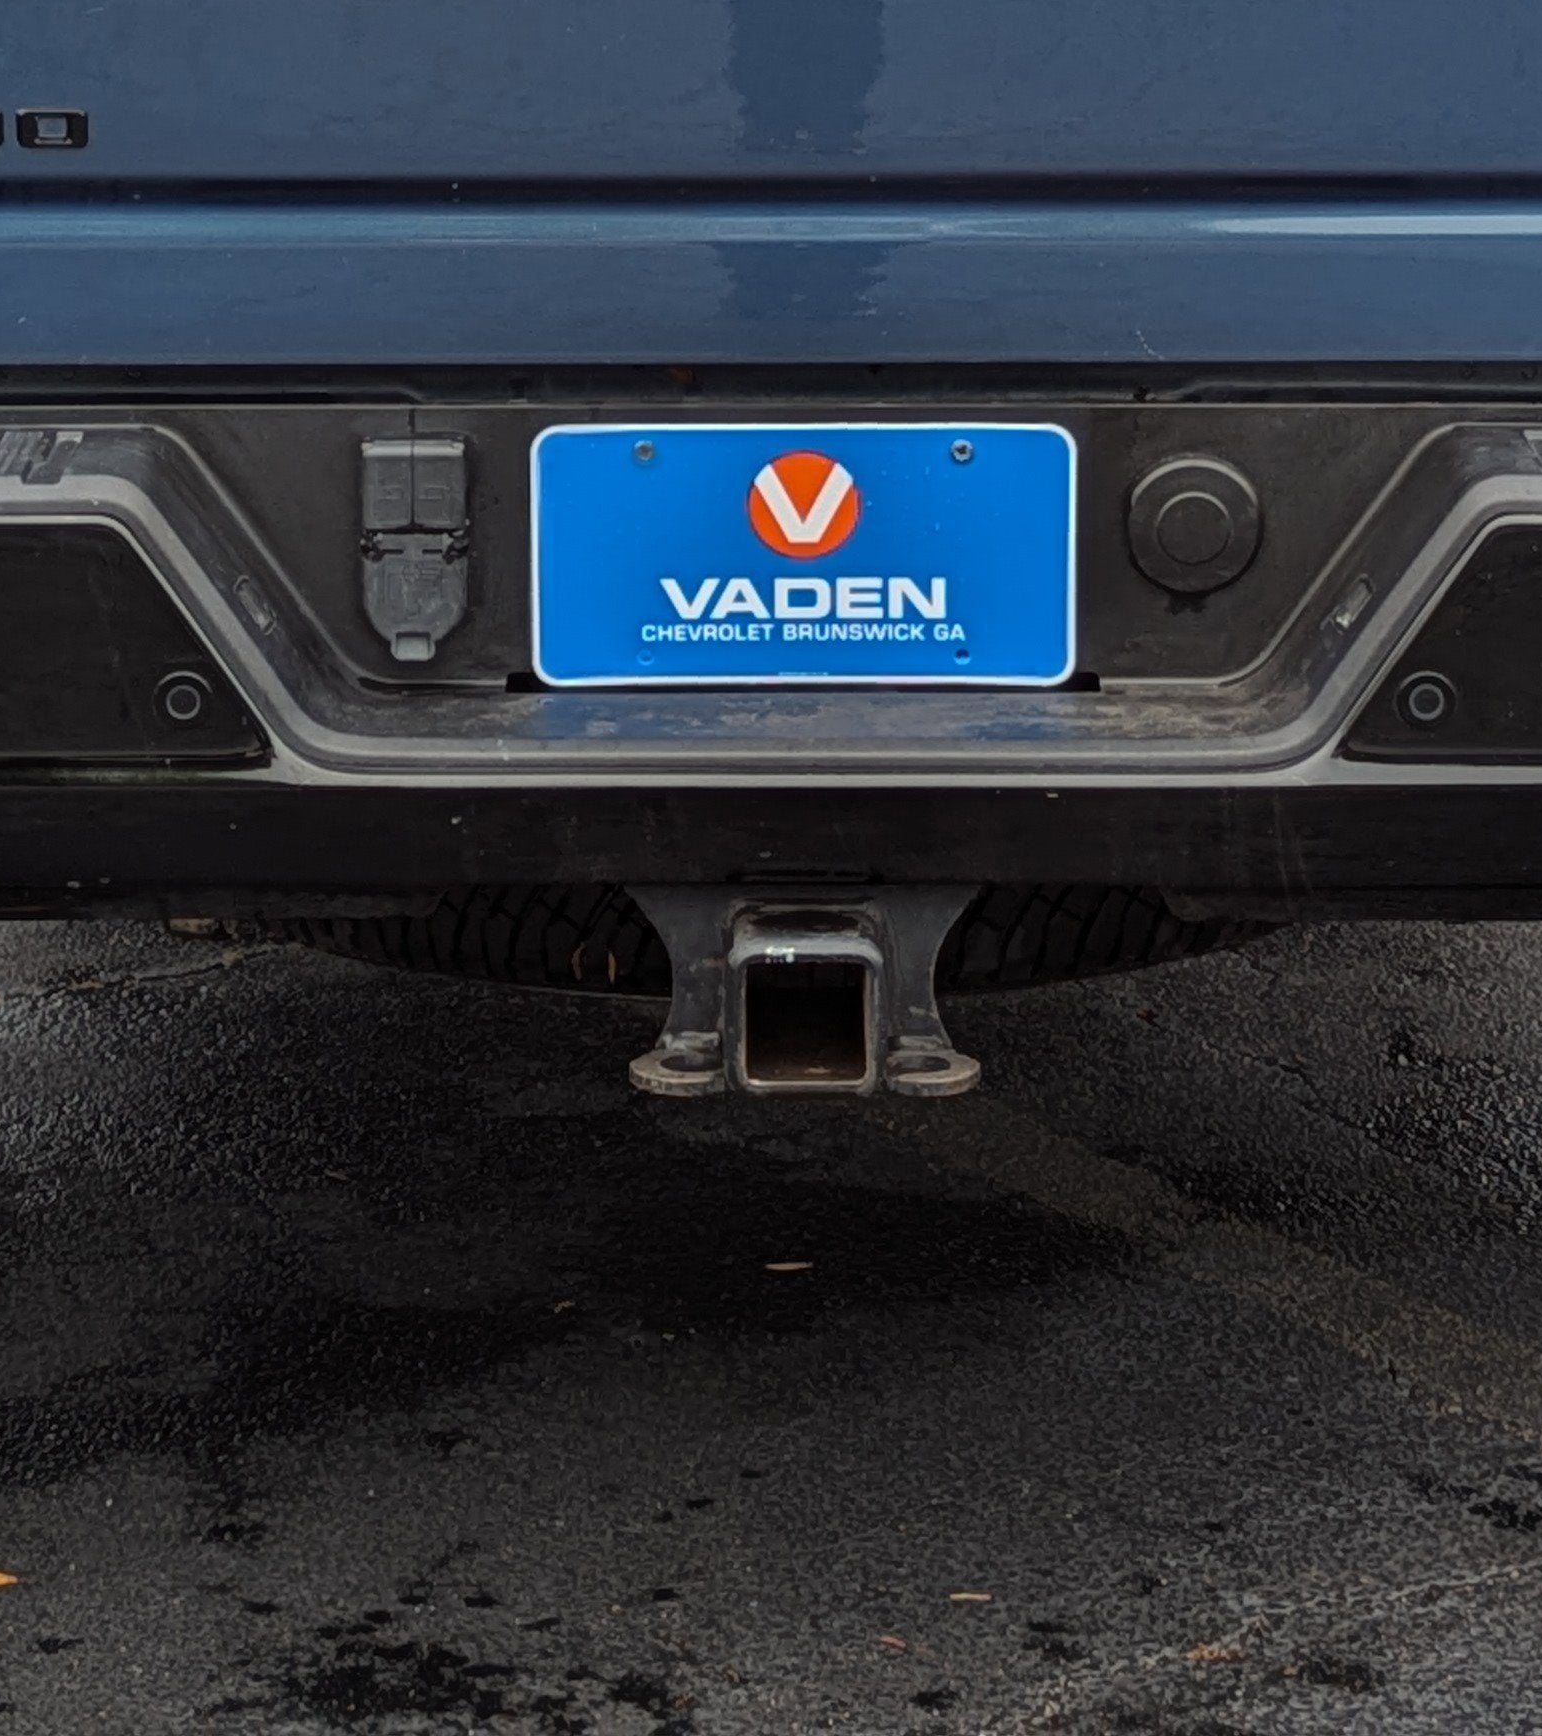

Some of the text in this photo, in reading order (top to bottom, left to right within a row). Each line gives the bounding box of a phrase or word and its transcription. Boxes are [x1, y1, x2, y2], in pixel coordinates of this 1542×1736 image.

[659, 576, 947, 620] VADEN
[641, 623, 967, 643] CHEVROLET BRUNSWICK GA
